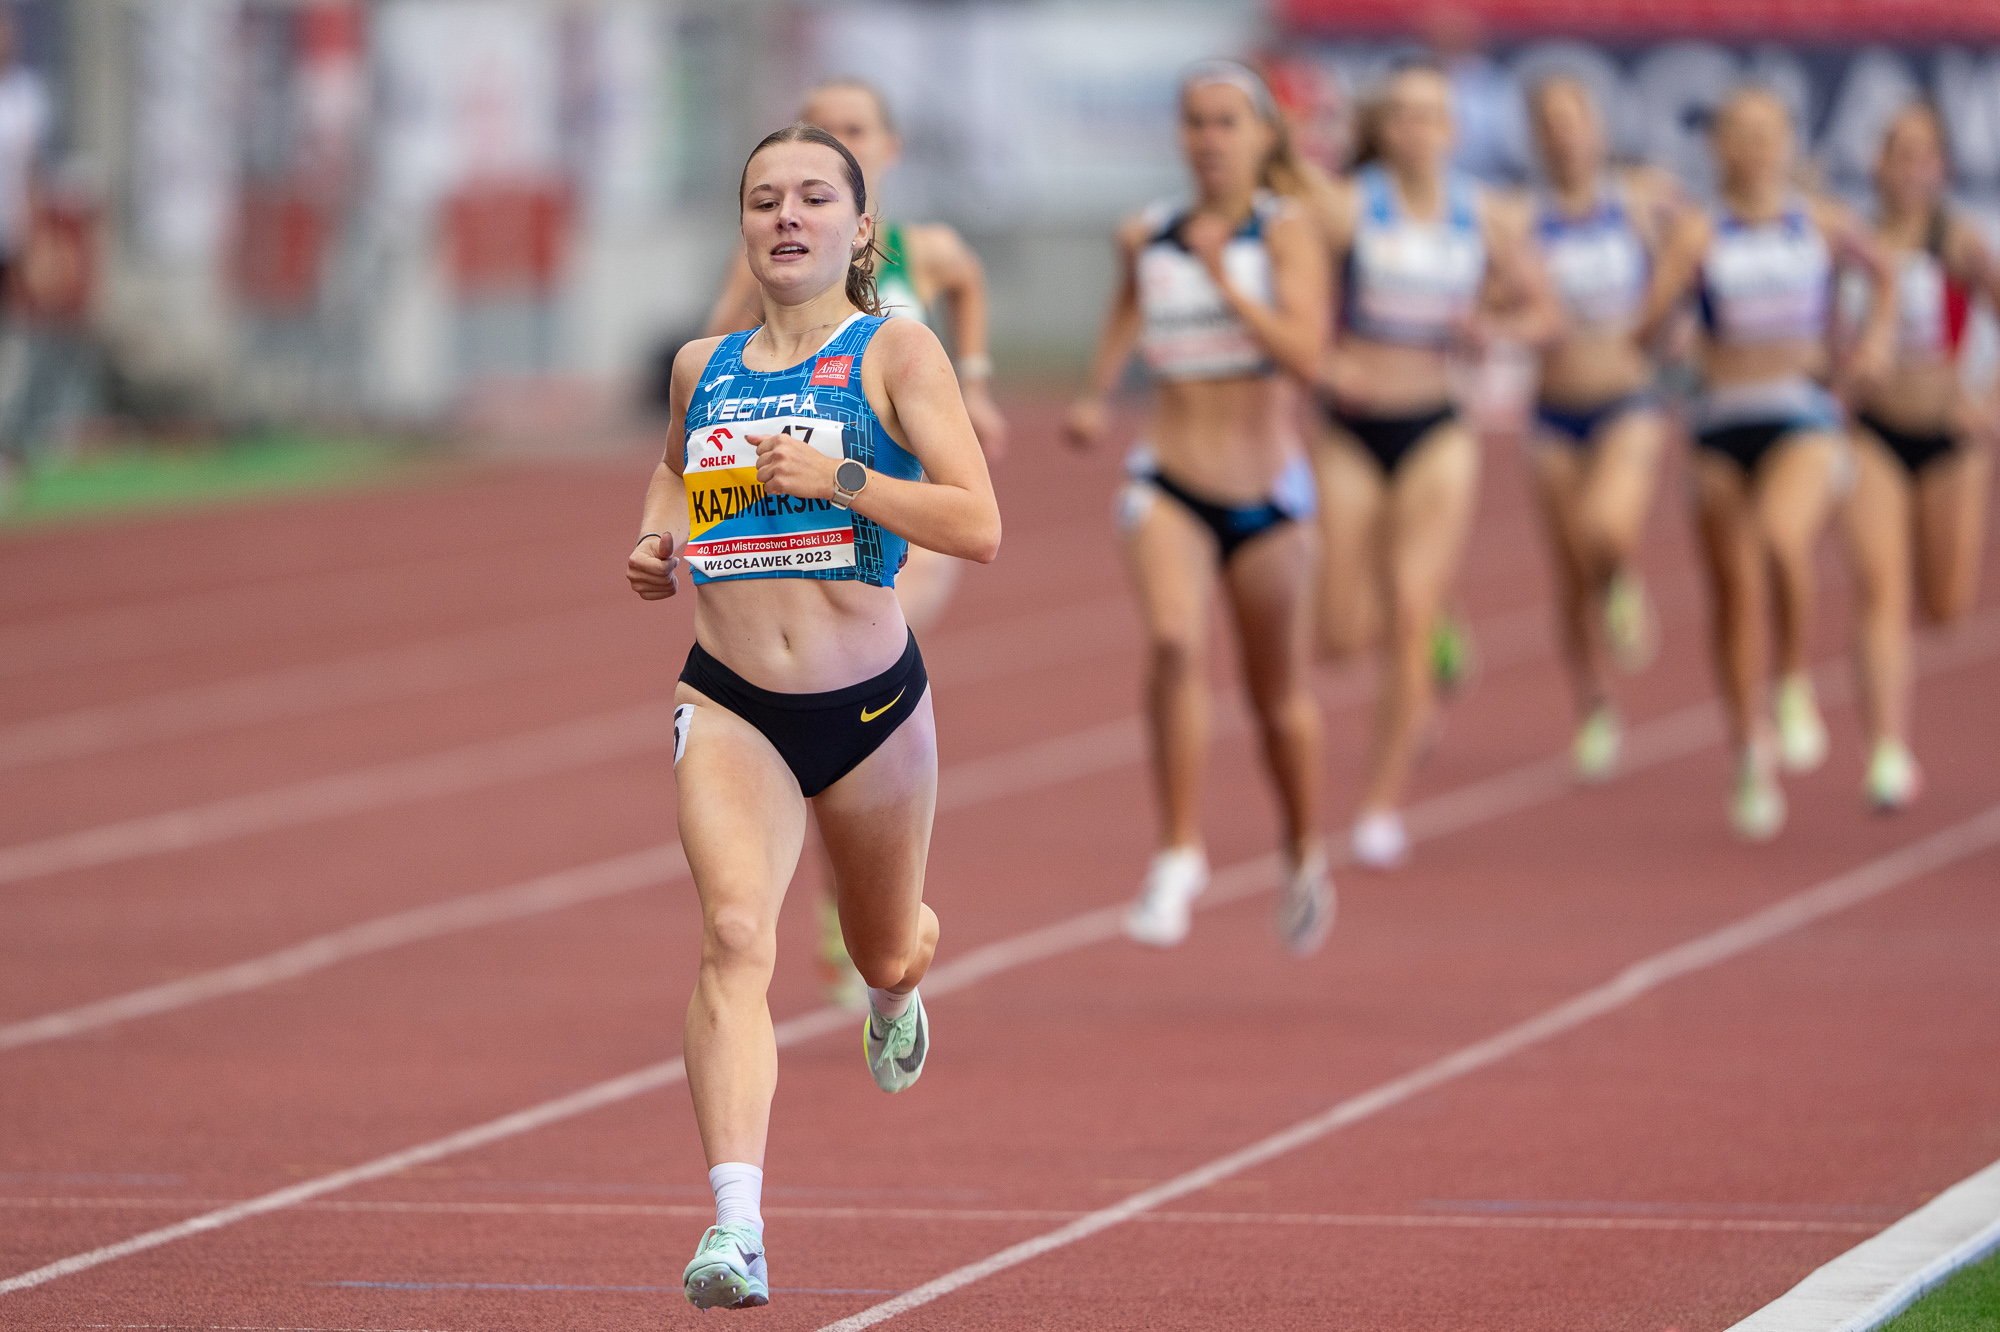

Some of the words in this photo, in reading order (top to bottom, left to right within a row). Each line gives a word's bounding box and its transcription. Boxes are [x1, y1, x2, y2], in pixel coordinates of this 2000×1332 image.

[817, 362, 848, 374] Anwil
[707, 393, 818, 421] VECTRA
[700, 455, 736, 468] ORLEN
[692, 484, 833, 524] KAZIMIERS
[697, 545, 711, 555] 40.
[712, 543, 731, 554] PZLA
[732, 539, 788, 551] Mistrzostwa
[790, 535, 820, 547] Polski
[822, 533, 842, 543] U23
[704, 554, 793, 571] WŁOCŁAWEK
[796, 550, 832, 565] 2023
